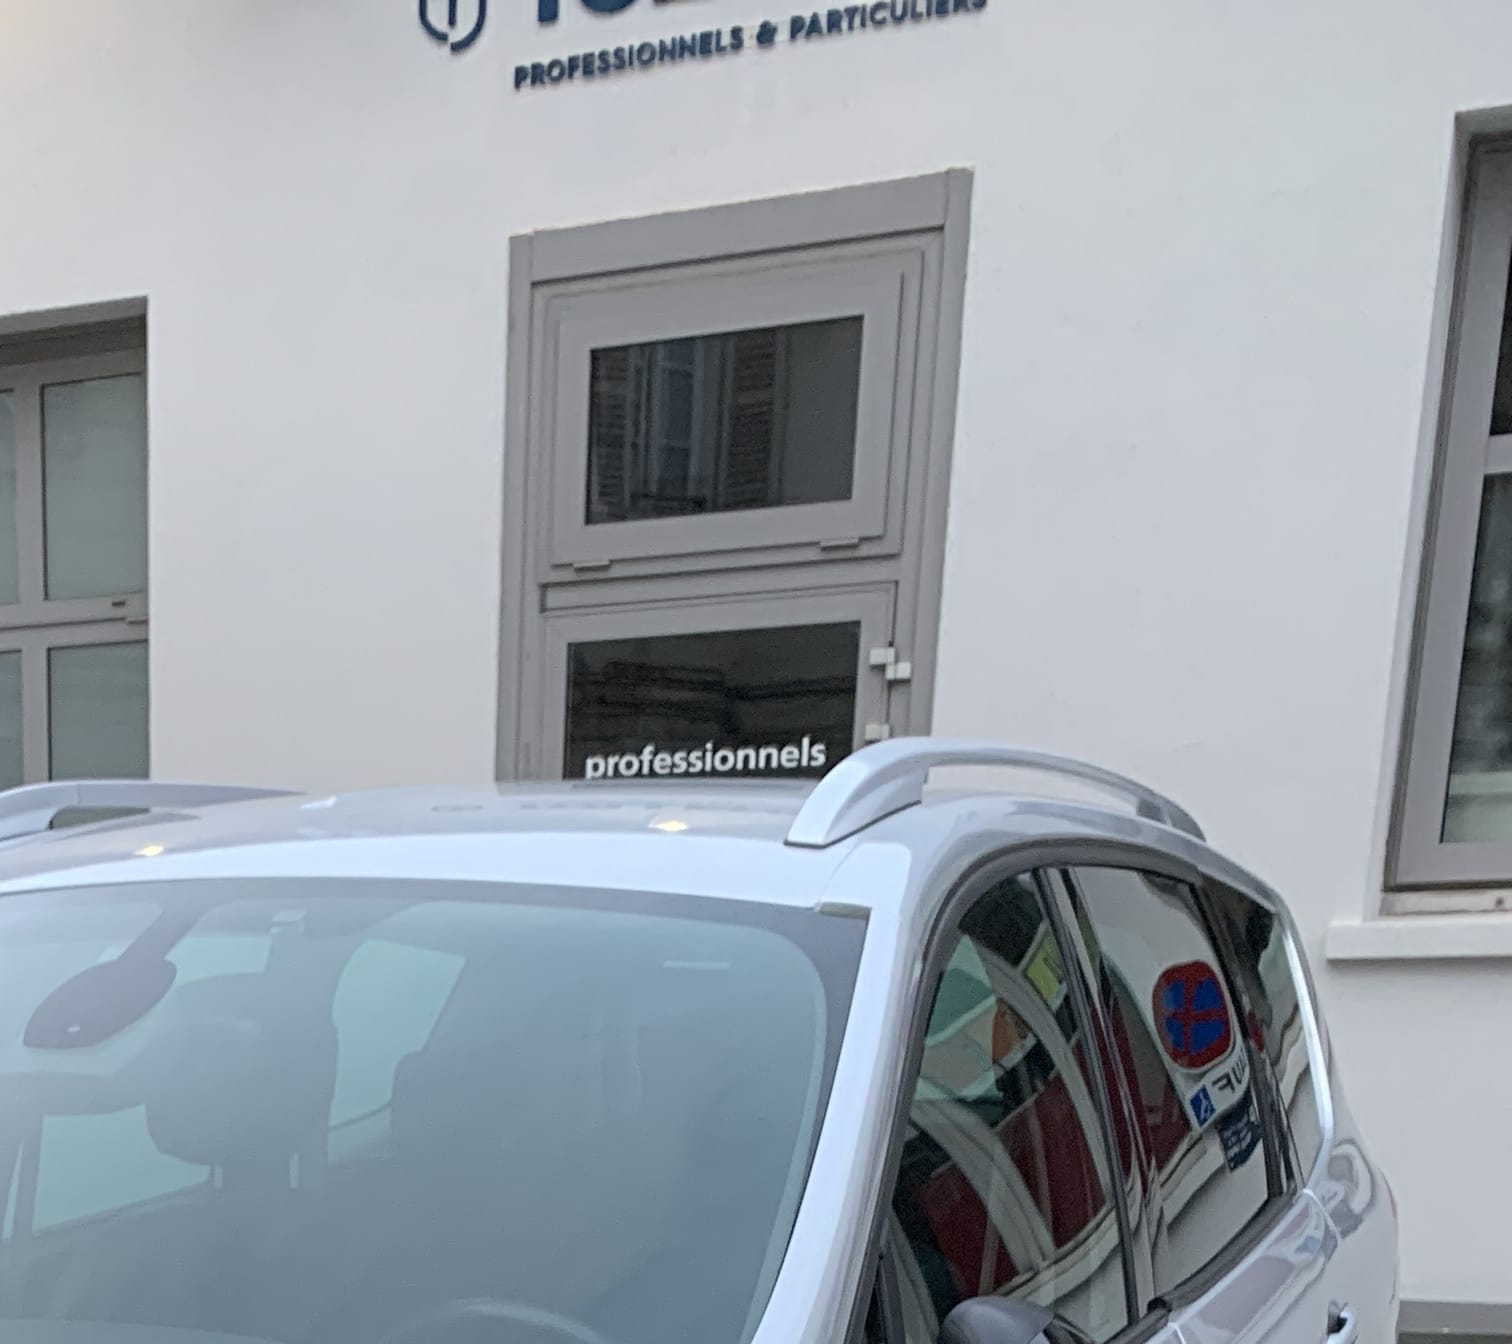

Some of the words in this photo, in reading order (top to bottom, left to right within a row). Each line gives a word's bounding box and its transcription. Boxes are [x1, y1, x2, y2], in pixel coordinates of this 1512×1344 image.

[514, 24, 744, 90] PROFESSIONNELS
[756, 20, 777, 45] &
[585, 734, 827, 780] professionnels
